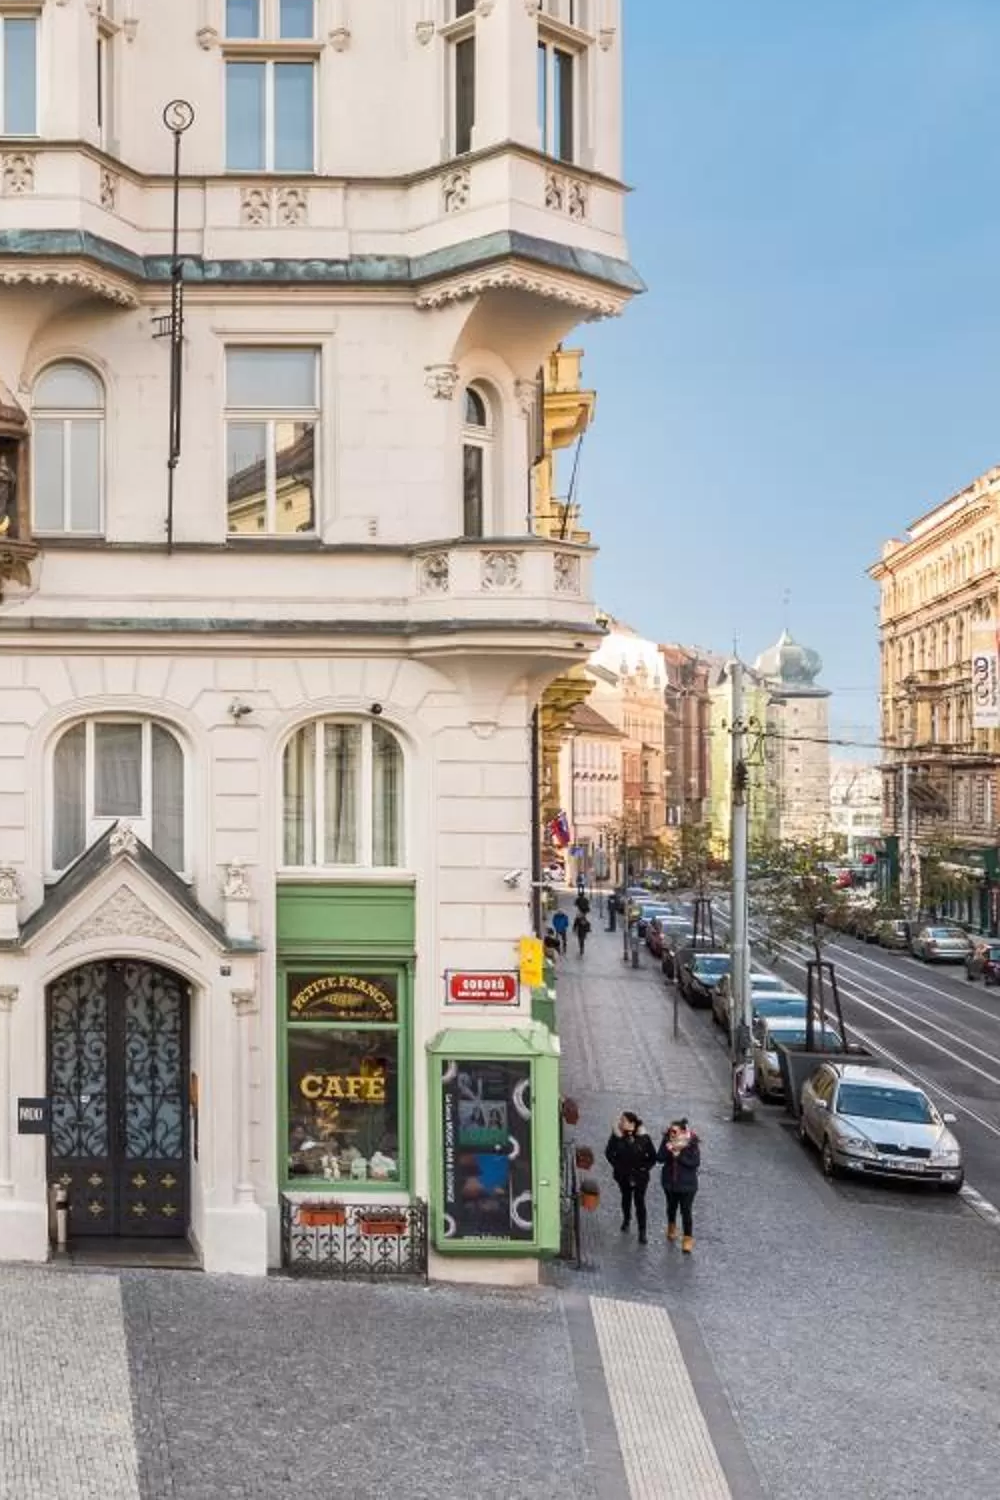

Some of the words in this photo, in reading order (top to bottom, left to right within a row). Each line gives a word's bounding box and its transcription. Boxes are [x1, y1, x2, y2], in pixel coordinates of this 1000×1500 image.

[291, 975, 338, 1011] PETITE
[339, 975, 394, 1012] FRANCE
[300, 1066, 386, 1099] CAFÉ
[446, 1121, 455, 1146] MUSIC
[446, 1148, 455, 1162] BAR
